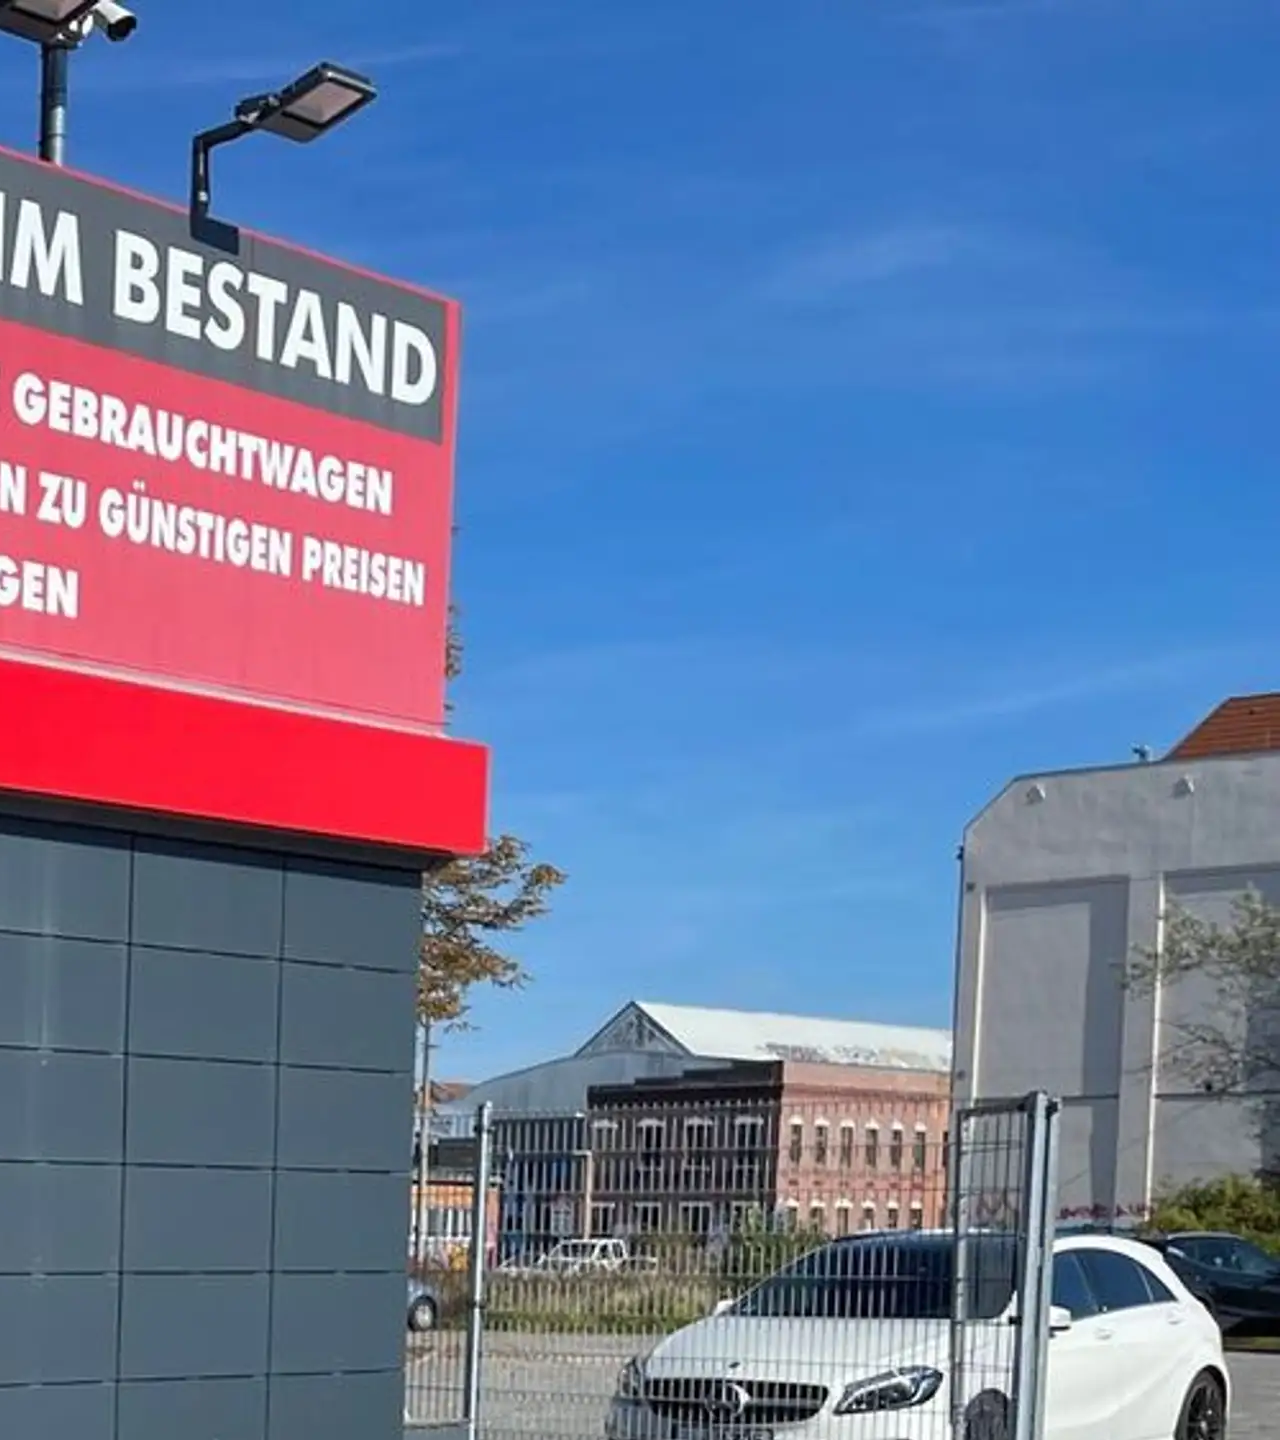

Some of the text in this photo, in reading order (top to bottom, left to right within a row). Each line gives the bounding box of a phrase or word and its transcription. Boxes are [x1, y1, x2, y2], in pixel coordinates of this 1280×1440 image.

[113, 229, 437, 407] BESTAND
[12, 371, 393, 516] GEBRAUCHTWAGEN
[38, 472, 87, 527] ZU
[99, 484, 291, 577] GÜNSTIGEN
[301, 529, 425, 607] PREISEN
